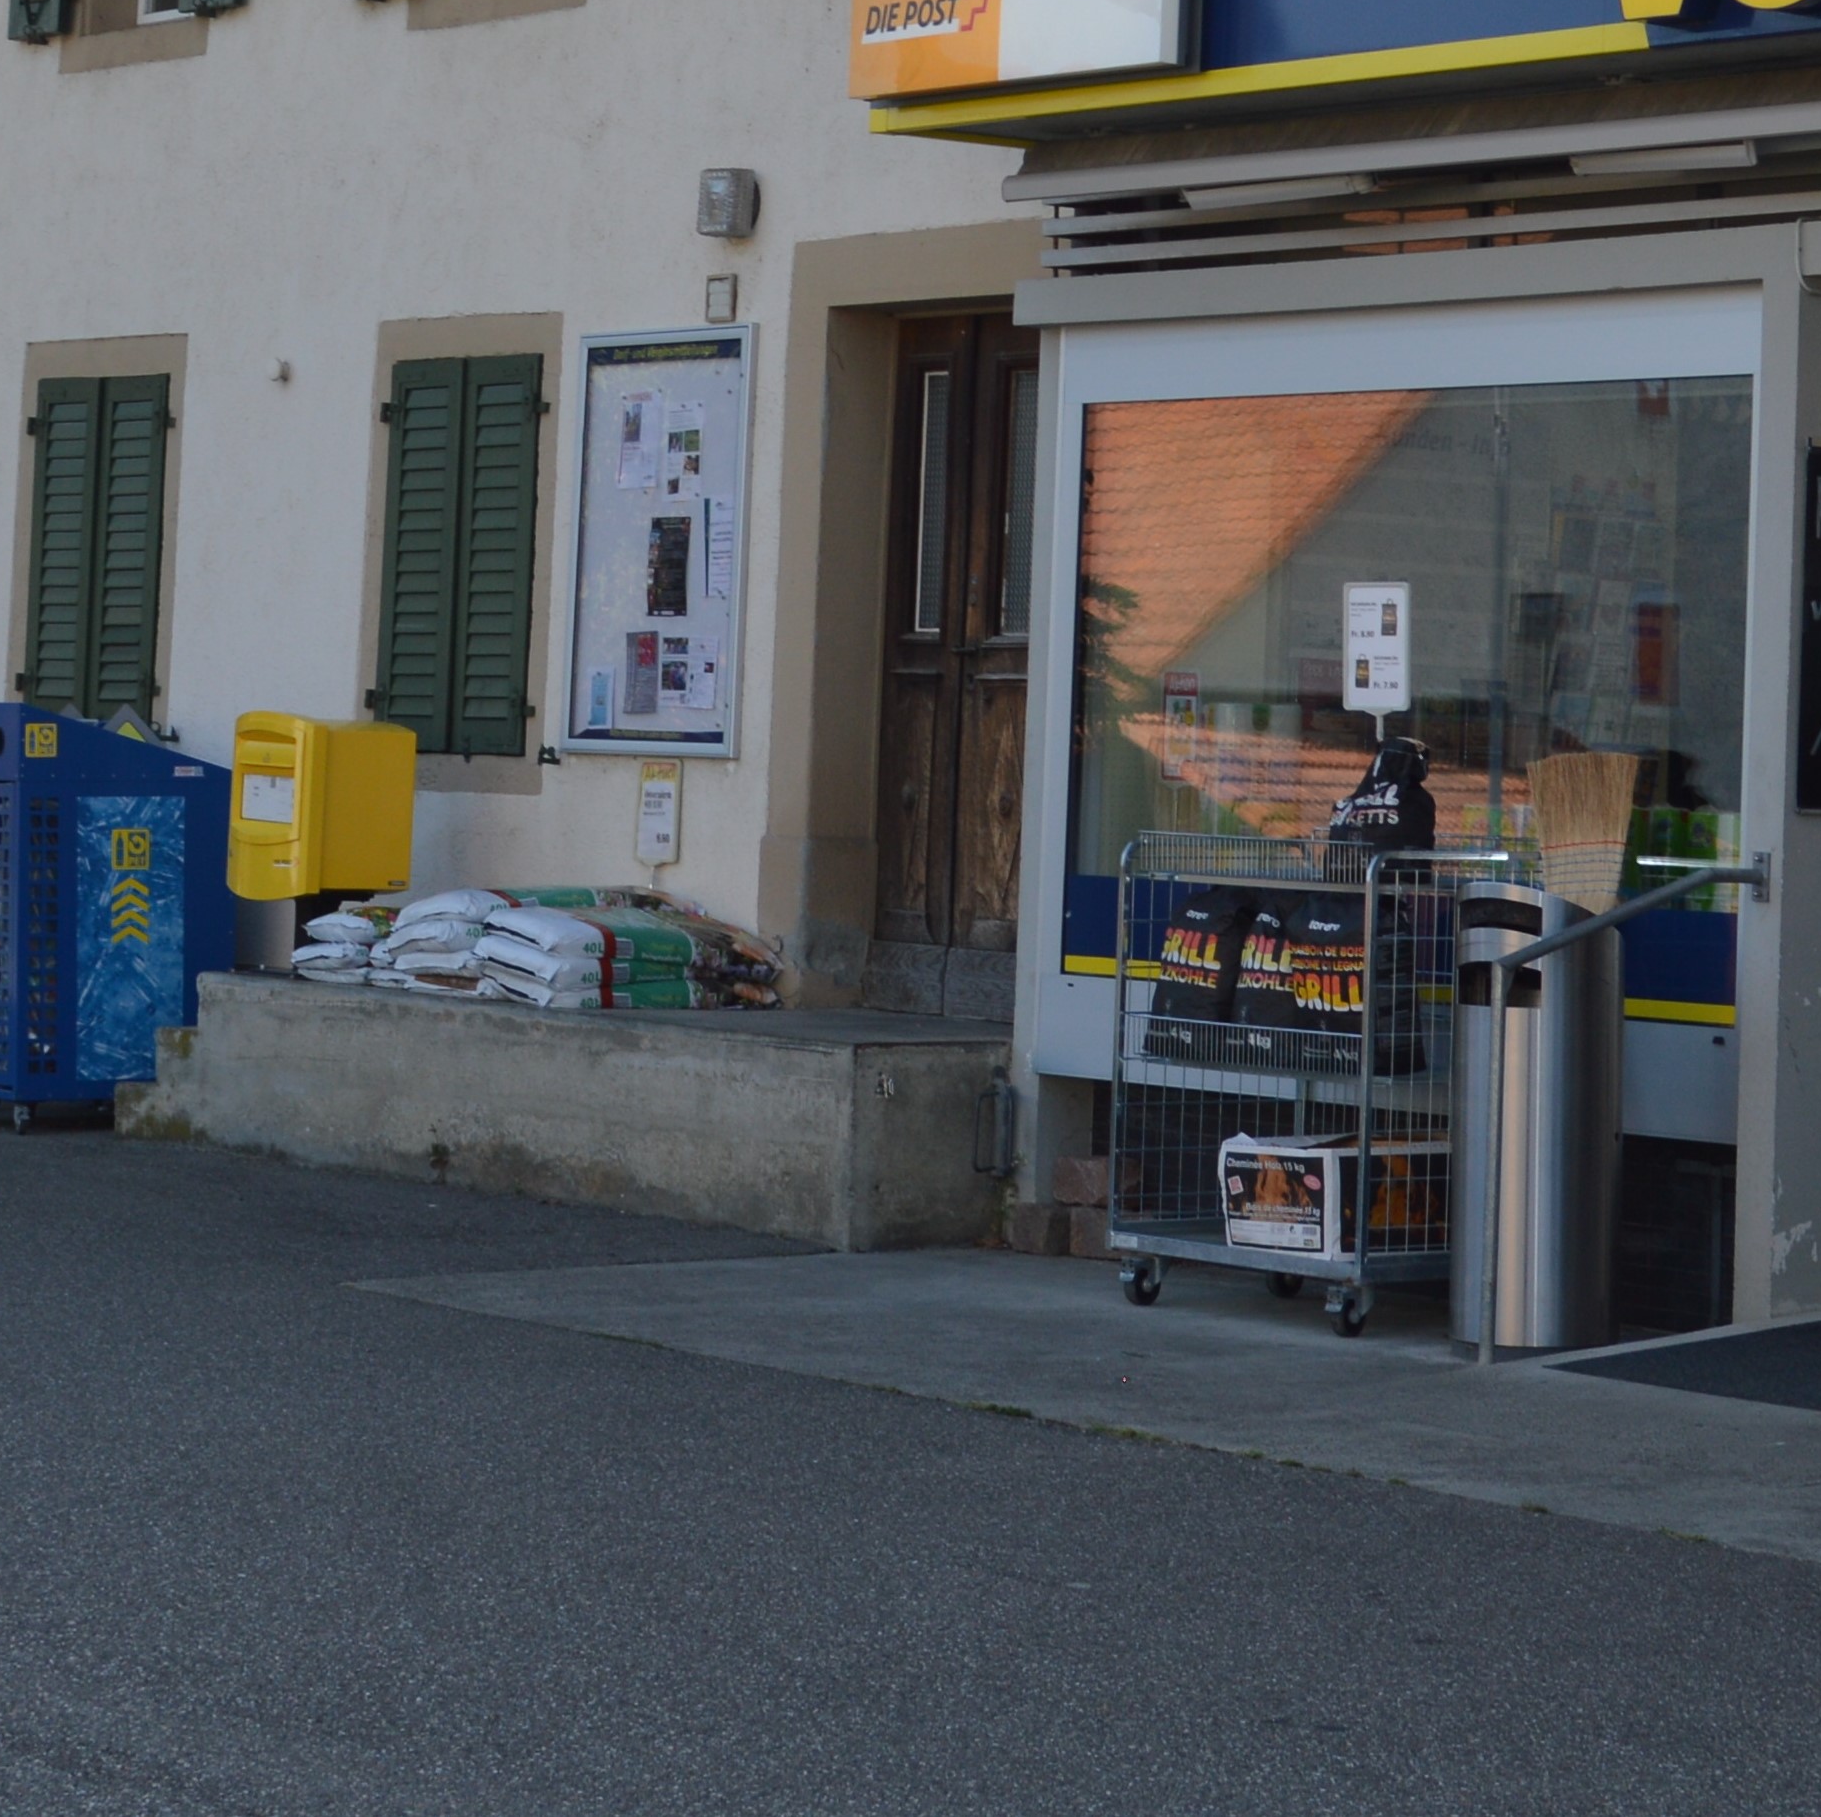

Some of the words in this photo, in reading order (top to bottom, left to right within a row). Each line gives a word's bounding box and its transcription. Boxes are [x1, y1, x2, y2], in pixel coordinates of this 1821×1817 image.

[865, 1, 900, 36] DIE
[583, 941, 604, 954] 40L
[1294, 972, 1364, 1013] GRILL
[1294, 1162, 1306, 1174] kg
